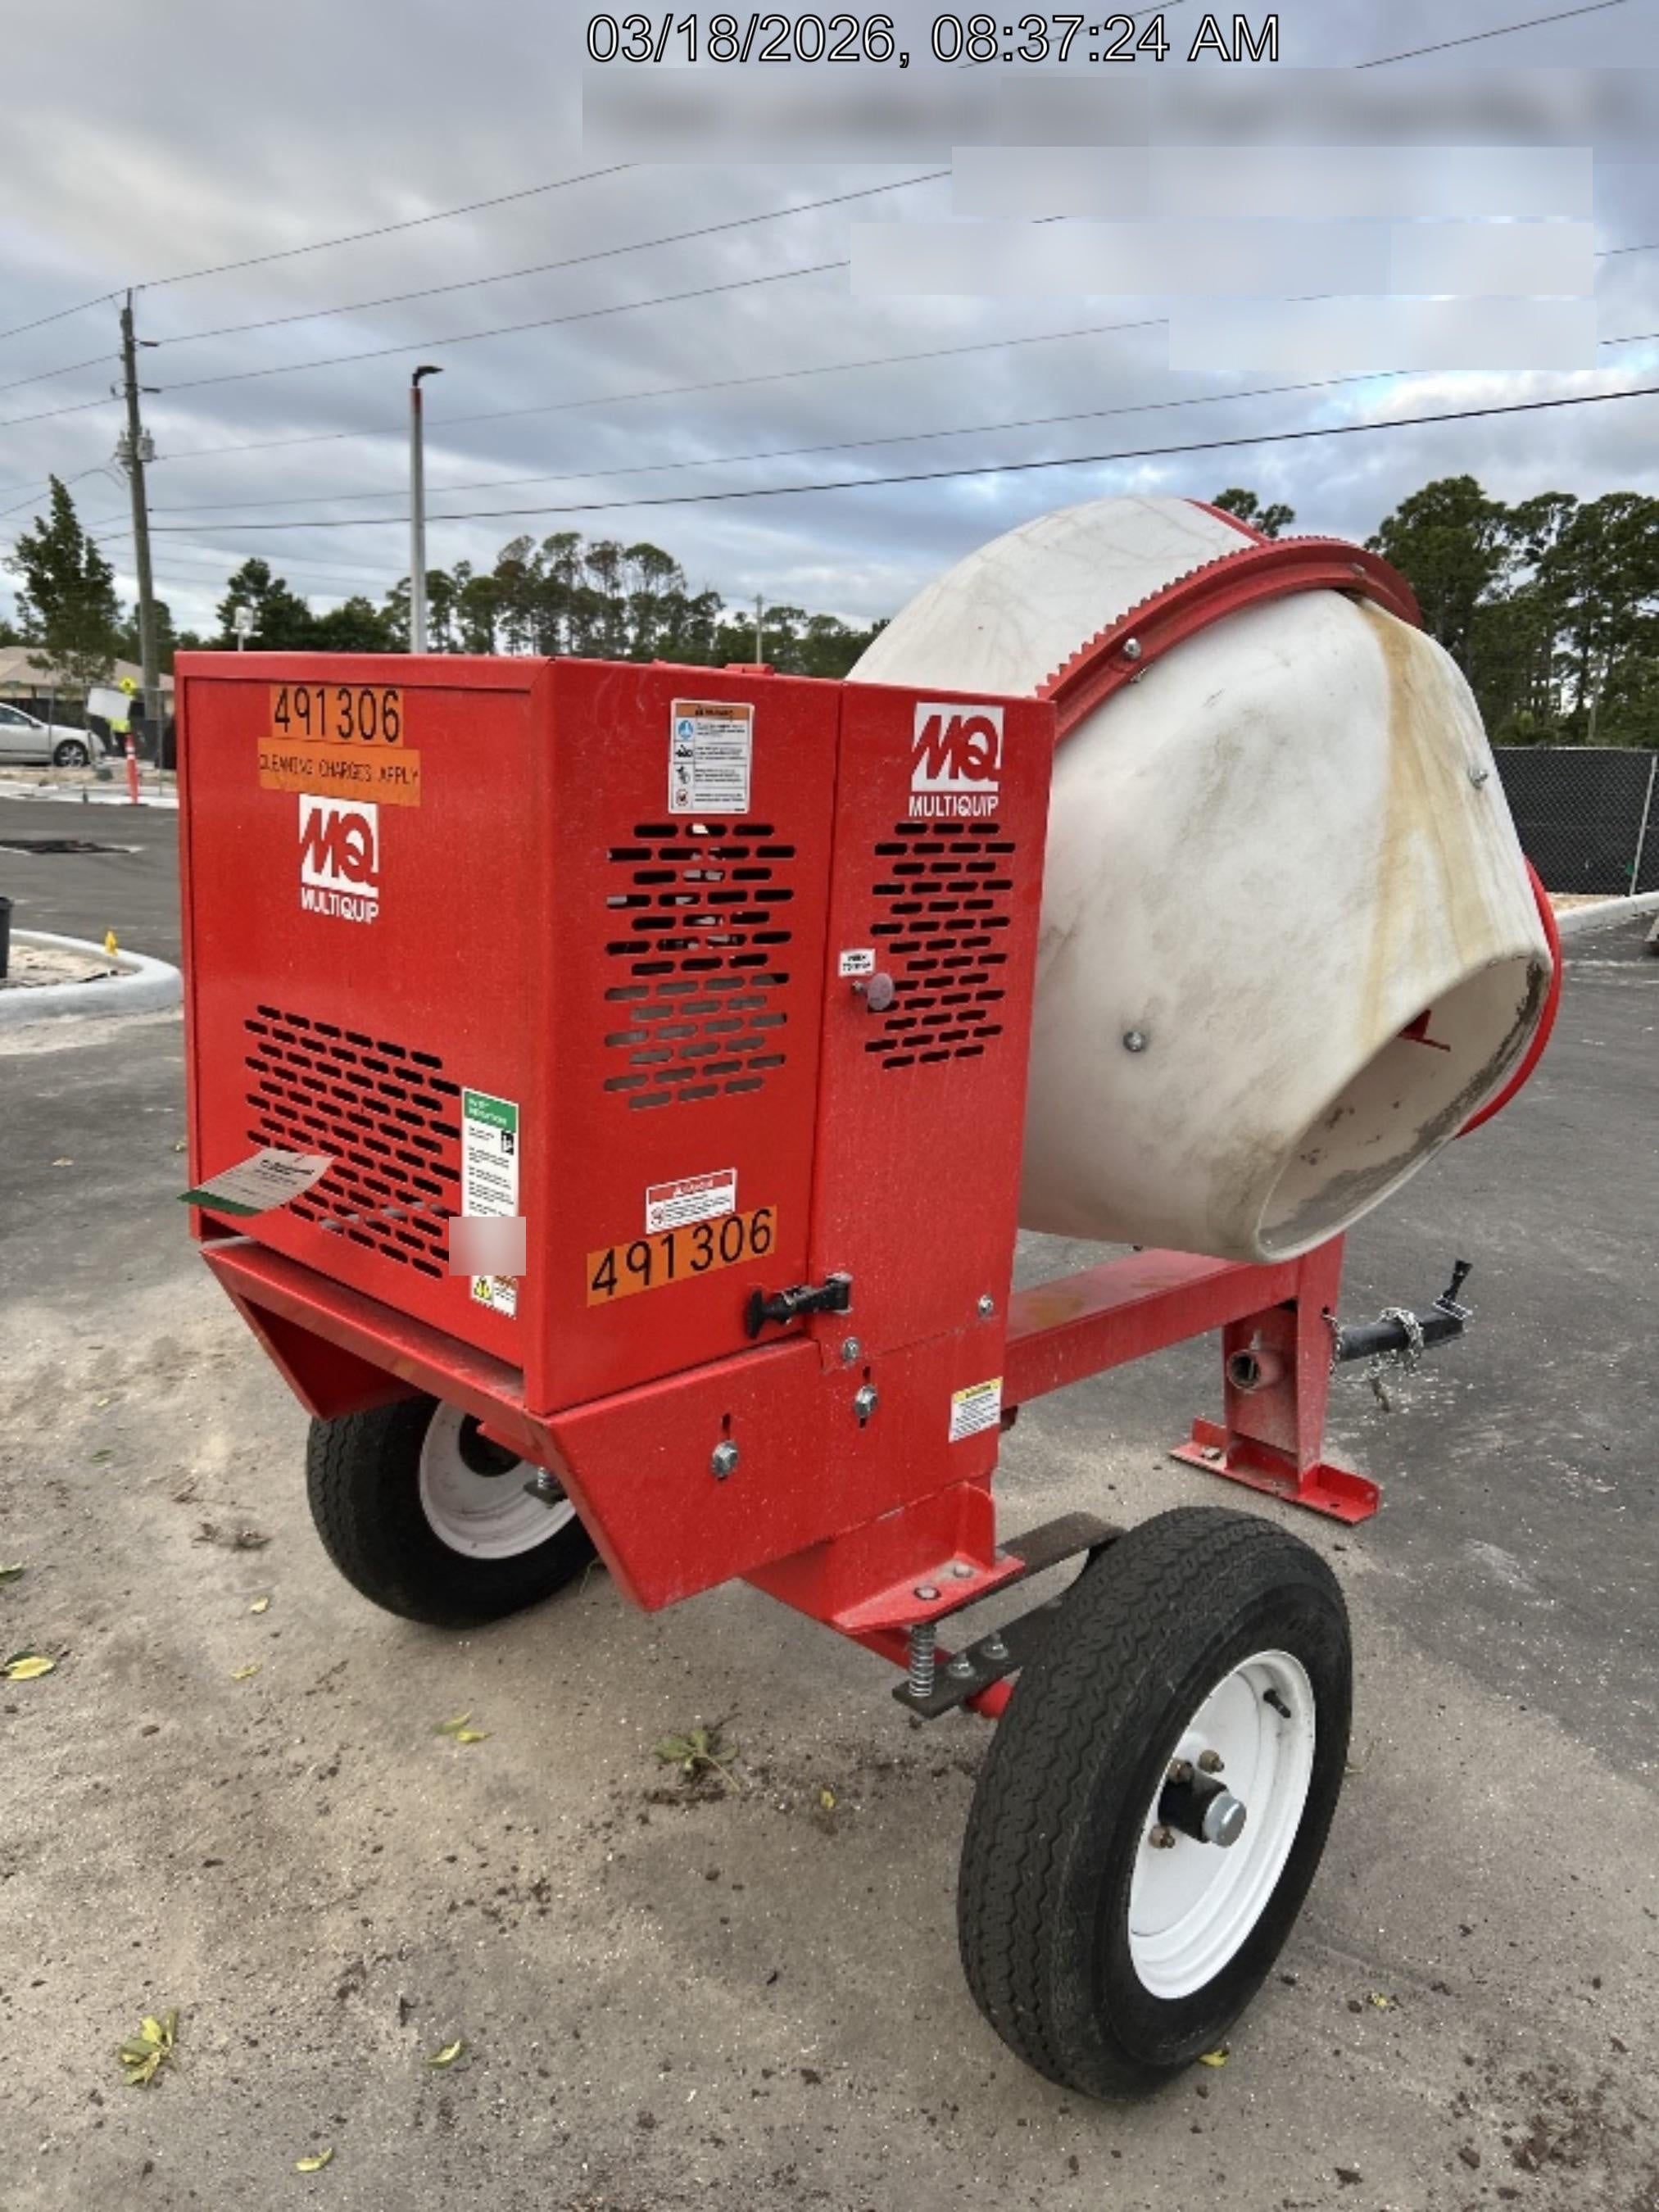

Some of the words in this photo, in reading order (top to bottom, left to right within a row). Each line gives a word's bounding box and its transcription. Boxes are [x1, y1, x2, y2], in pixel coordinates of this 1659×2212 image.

[274, 687, 401, 743] 491306
[911, 714, 1001, 783] MQ
[909, 794, 999, 818] MULTIQUIP
[299, 806, 379, 888] MQ
[300, 886, 379, 925] MULTIQUIP
[592, 1208, 772, 1297] 491306
